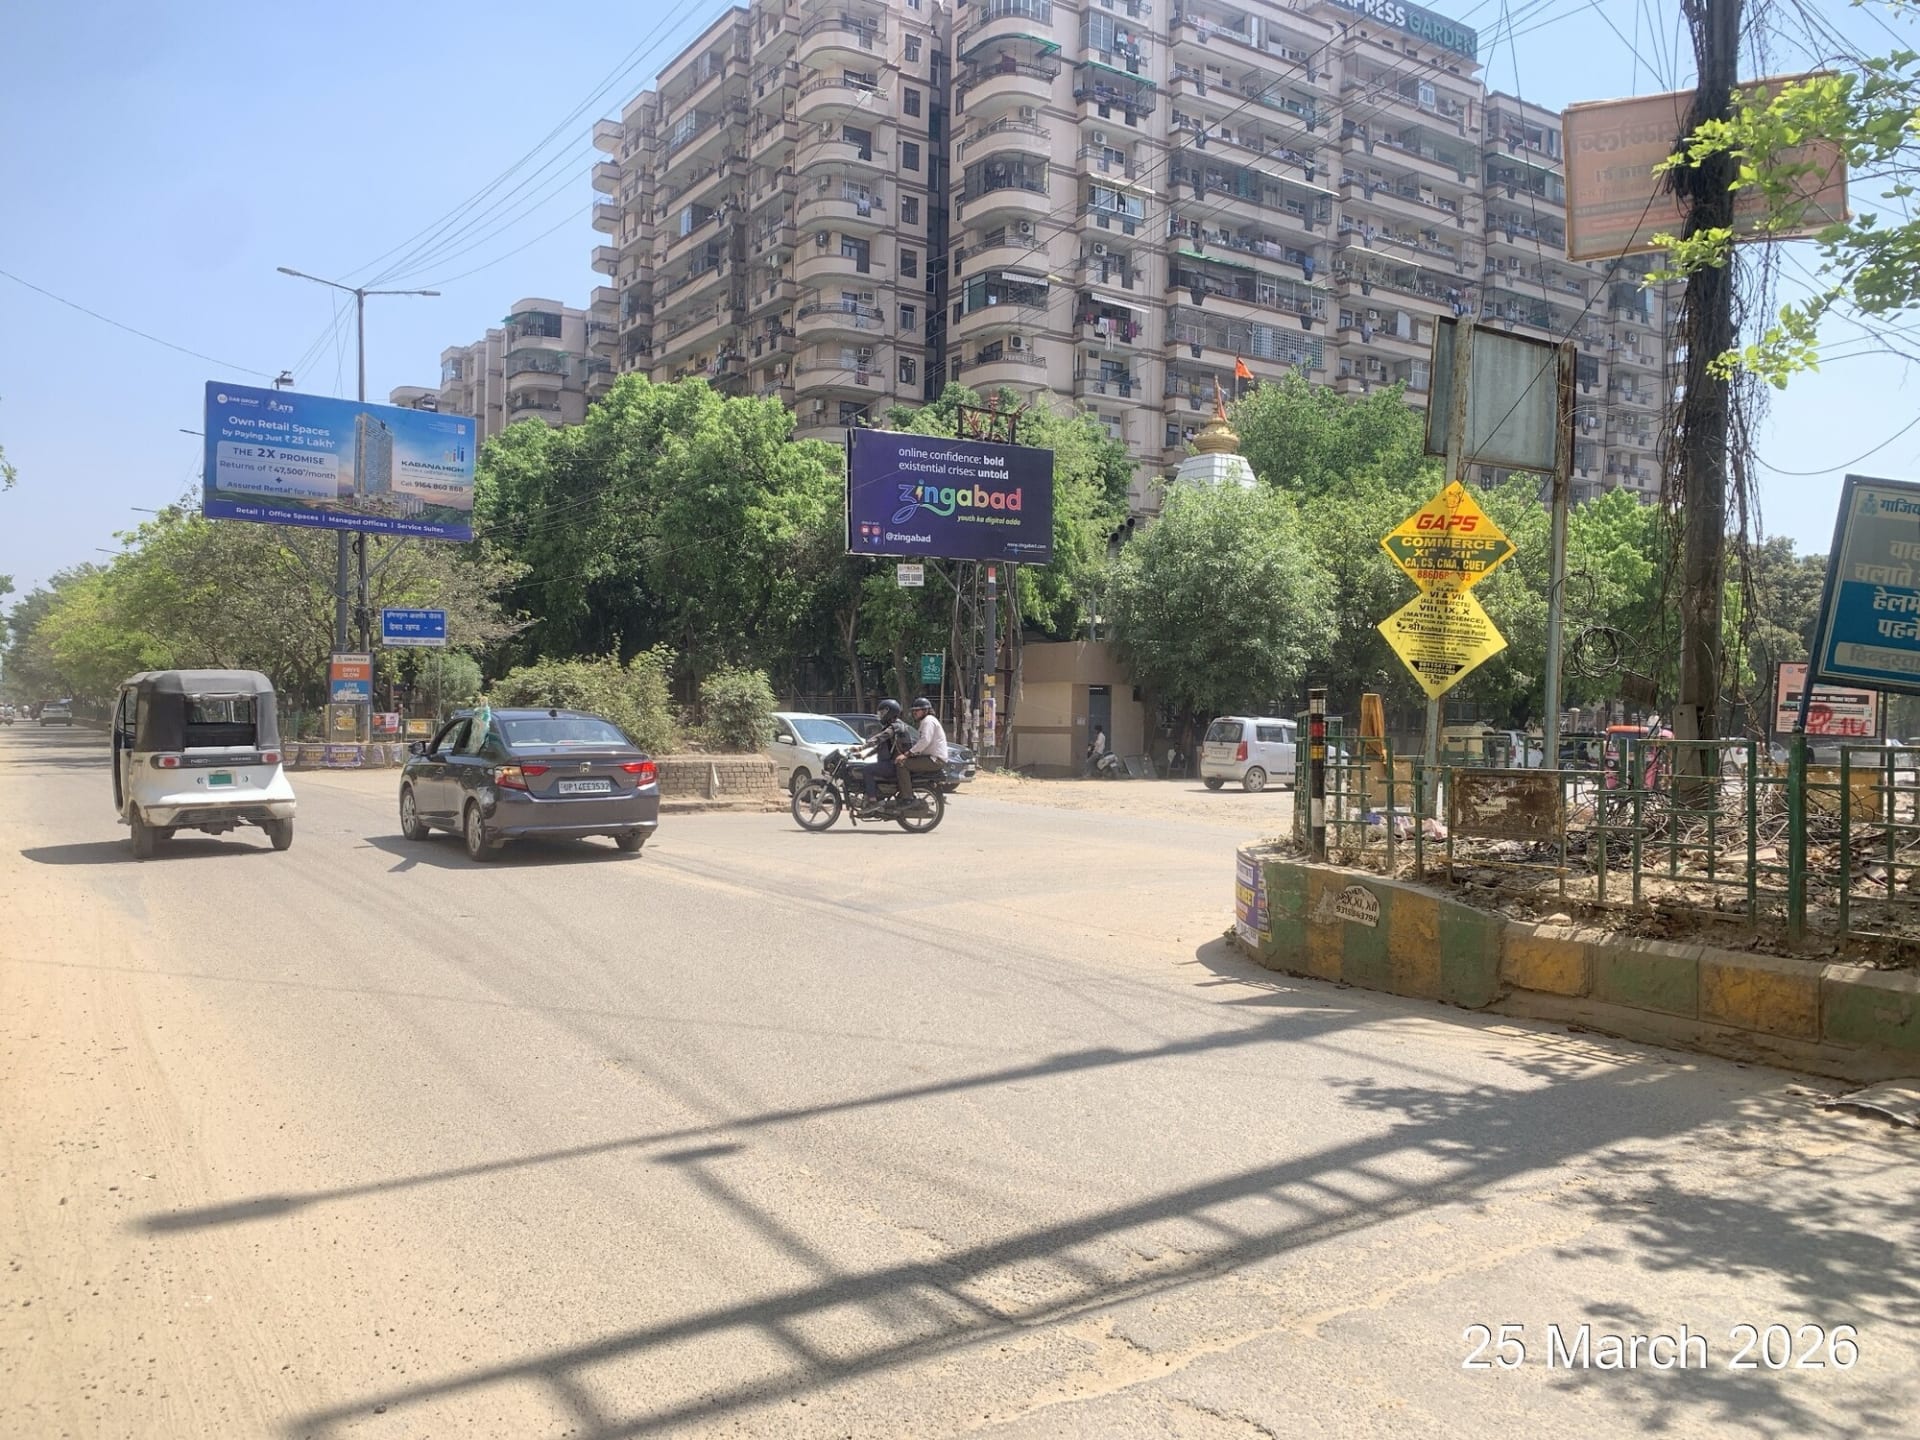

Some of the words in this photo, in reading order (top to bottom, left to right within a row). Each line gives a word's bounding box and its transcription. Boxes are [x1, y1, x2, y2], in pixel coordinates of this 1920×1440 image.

[1409, 12, 1478, 54] GARDEN
[228, 416, 255, 427] Own
[258, 419, 289, 431] Retail
[292, 424, 330, 436] Spaces
[222, 428, 232, 436] by
[235, 430, 263, 441] Paying
[266, 434, 282, 442] Just
[292, 436, 304, 444] 25
[233, 448, 253, 456] THE
[257, 448, 276, 458] 2X
[280, 453, 324, 464] PROMISE
[898, 448, 928, 458] online
[929, 451, 982, 464] confidence:
[983, 455, 1004, 466] bold
[220, 460, 254, 471] Returns
[257, 464, 266, 472] of
[899, 460, 946, 474] existential
[948, 466, 976, 476] crises:
[978, 470, 1009, 480] untold
[227, 482, 261, 490] Assured
[892, 479, 1022, 524] zingabad
[236, 507, 258, 515] Retail
[269, 510, 291, 518] Office
[293, 513, 318, 521] Spaces
[328, 516, 361, 525] Managed
[363, 520, 387, 528] Offices
[397, 522, 421, 531] Service
[985, 516, 1005, 525] digital
[1416, 514, 1479, 532] GAPS
[886, 532, 931, 544] @zingabad
[1402, 537, 1495, 550] COMMERCE
[1405, 557, 1419, 569] CA,
[1421, 558, 1435, 569] CS,
[1437, 559, 1460, 571] CMA,
[1463, 560, 1486, 570] CUET
[1419, 604, 1440, 614] VIII,
[1444, 606, 1459, 615] IX,
[1446, 616, 1484, 624] SCIENCE)
